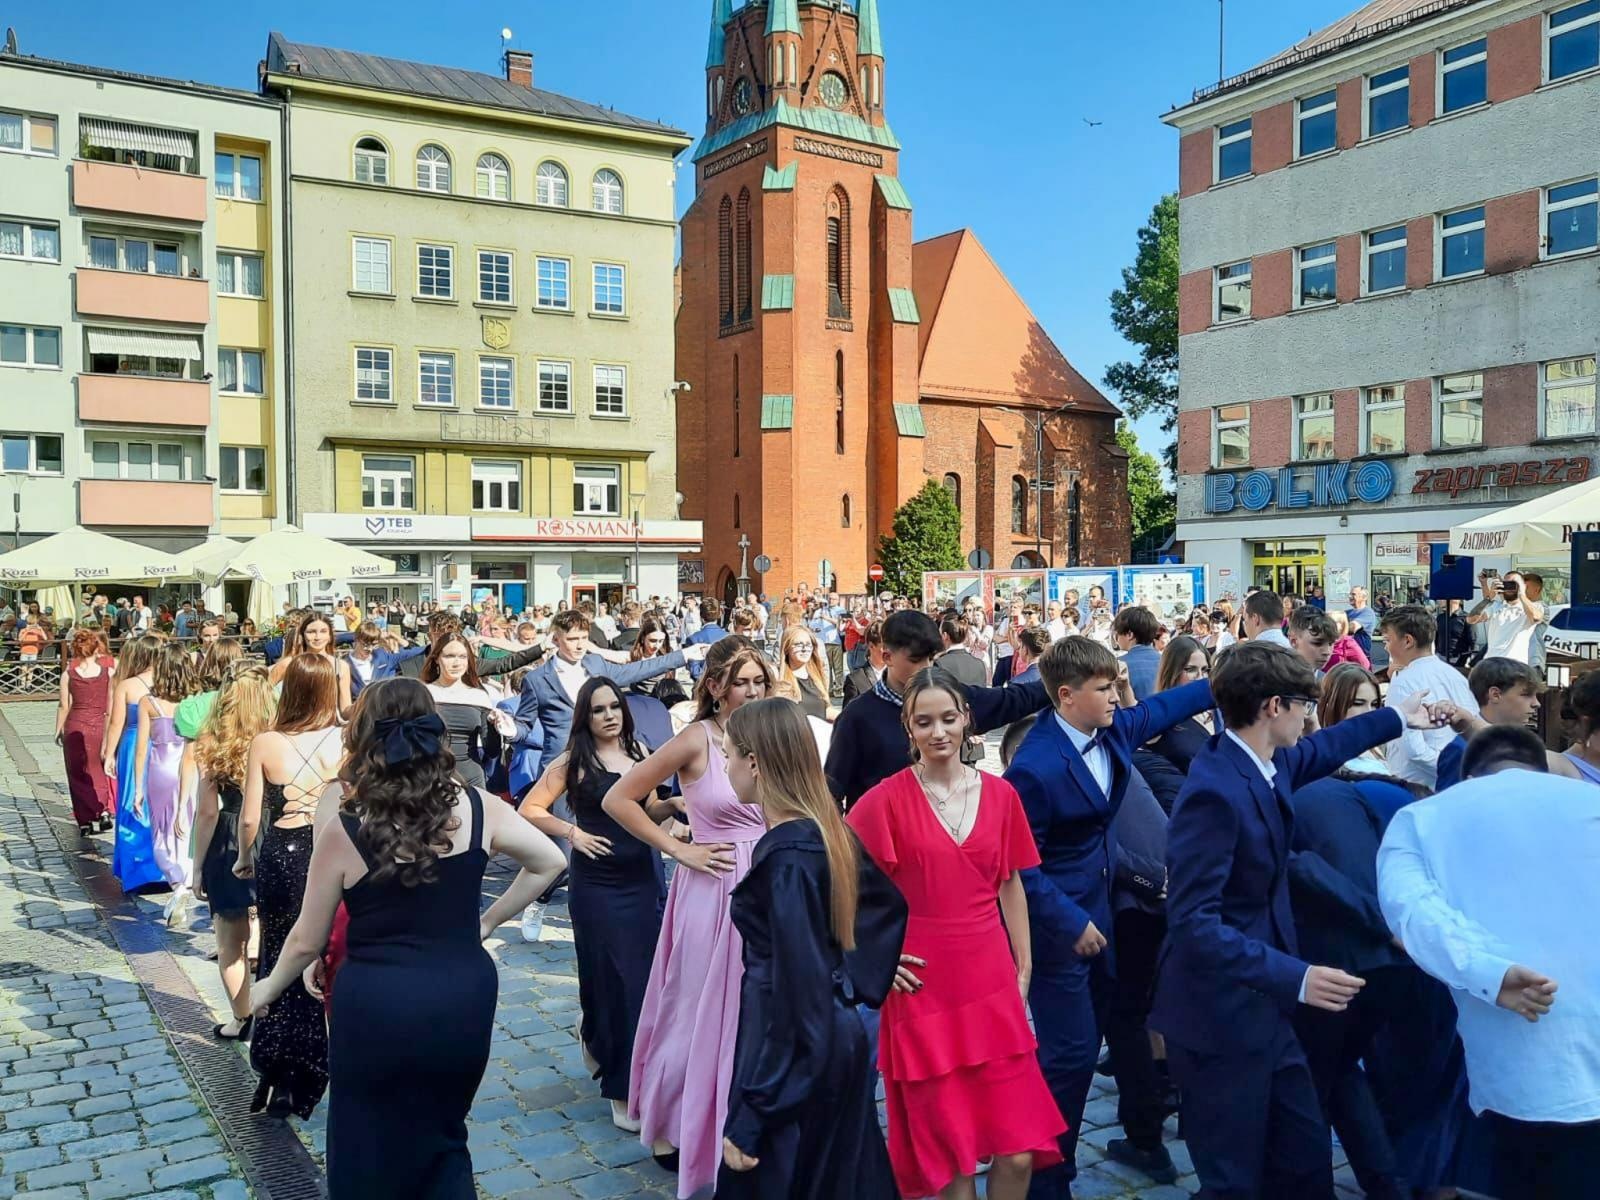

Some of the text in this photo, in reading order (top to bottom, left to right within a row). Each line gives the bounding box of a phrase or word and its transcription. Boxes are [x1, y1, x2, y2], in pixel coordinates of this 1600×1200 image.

[1204, 456, 1591, 514] BOLKO zaprasza
[387, 517, 412, 527] TEB
[537, 520, 643, 536] ROSSMANN
[1, 568, 39, 578] Kozel
[75, 568, 110, 577] Kozel
[143, 565, 180, 575] Kozel
[292, 569, 322, 580] Kozel
[352, 565, 381, 575] Kozel
